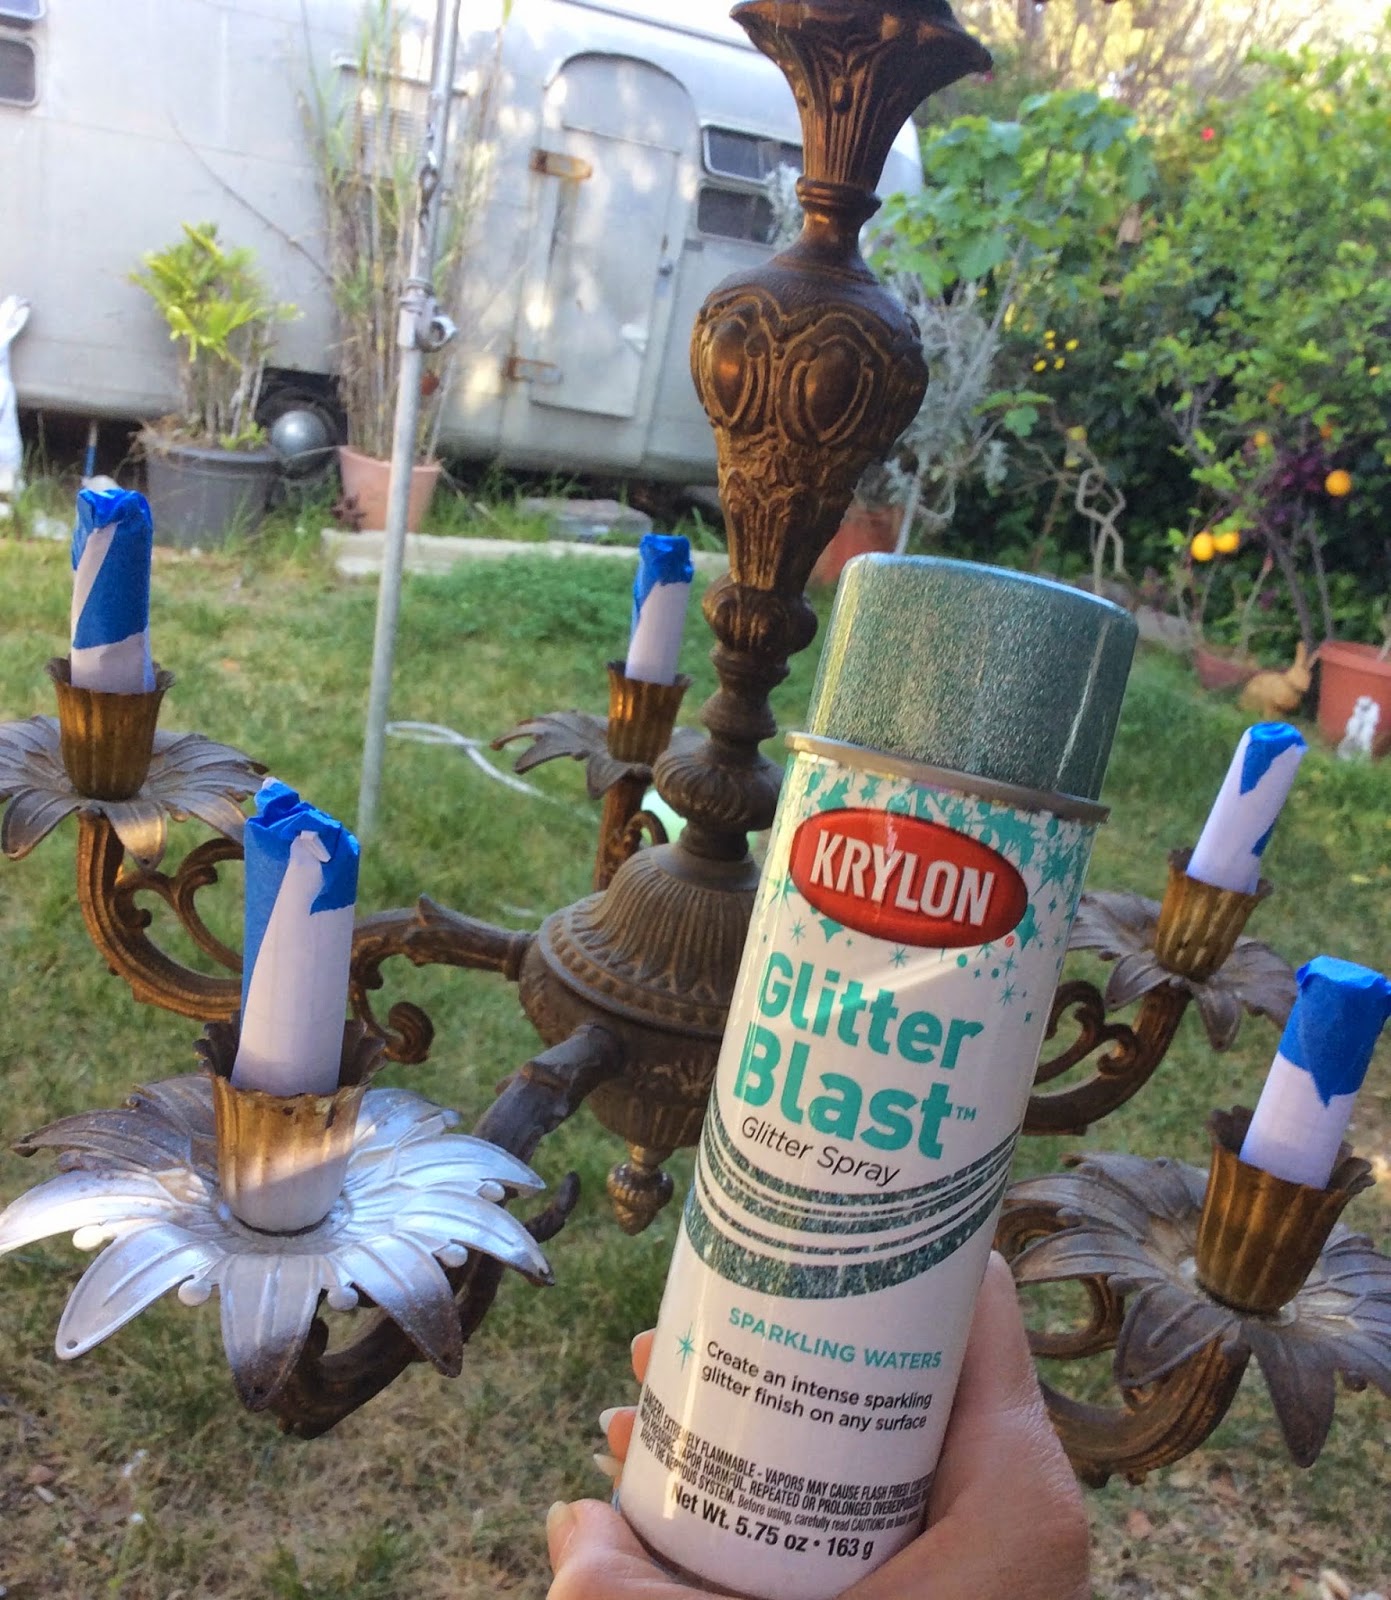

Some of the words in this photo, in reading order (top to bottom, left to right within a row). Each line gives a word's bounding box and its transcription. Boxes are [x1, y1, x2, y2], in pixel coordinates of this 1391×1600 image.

[809, 829, 995, 927] KRYLON
[758, 951, 984, 1069] Glitter
[742, 1116, 813, 1159] Glitter
[817, 1146, 900, 1187] Spray
[729, 1307, 855, 1363] SPARKLING
[864, 1348, 943, 1370] WATERS
[701, 1363, 751, 1398] glitter
[754, 1386, 804, 1417] finish
[810, 1407, 834, 1425] on
[839, 1413, 872, 1432] any
[875, 1414, 927, 1431] surface
[706, 1340, 759, 1377] Create
[763, 1369, 786, 1388] an
[791, 1375, 860, 1406] intense
[864, 1392, 933, 1411] sparkling
[698, 1474, 735, 1504] SYSTEM.
[737, 1494, 765, 1516] Before
[767, 1506, 793, 1525] using,
[795, 1513, 830, 1532] carefully
[832, 1518, 851, 1532] read
[701, 1440, 756, 1478] FLAMMABLE
[765, 1467, 805, 1493] VAPORS
[806, 1479, 829, 1497] MAY
[829, 1483, 861, 1500] CAUSE
[861, 1485, 889, 1501] FLASH
[749, 1480, 800, 1508] REPEATED
[802, 1495, 816, 1511] OR
[817, 1498, 872, 1516] PROLONGED
[672, 1483, 698, 1514] Net
[702, 1499, 730, 1530] Wt.
[735, 1515, 780, 1546] 5.75
[784, 1534, 809, 1552] oz
[827, 1536, 860, 1557] 163
[861, 1540, 875, 1561] g
